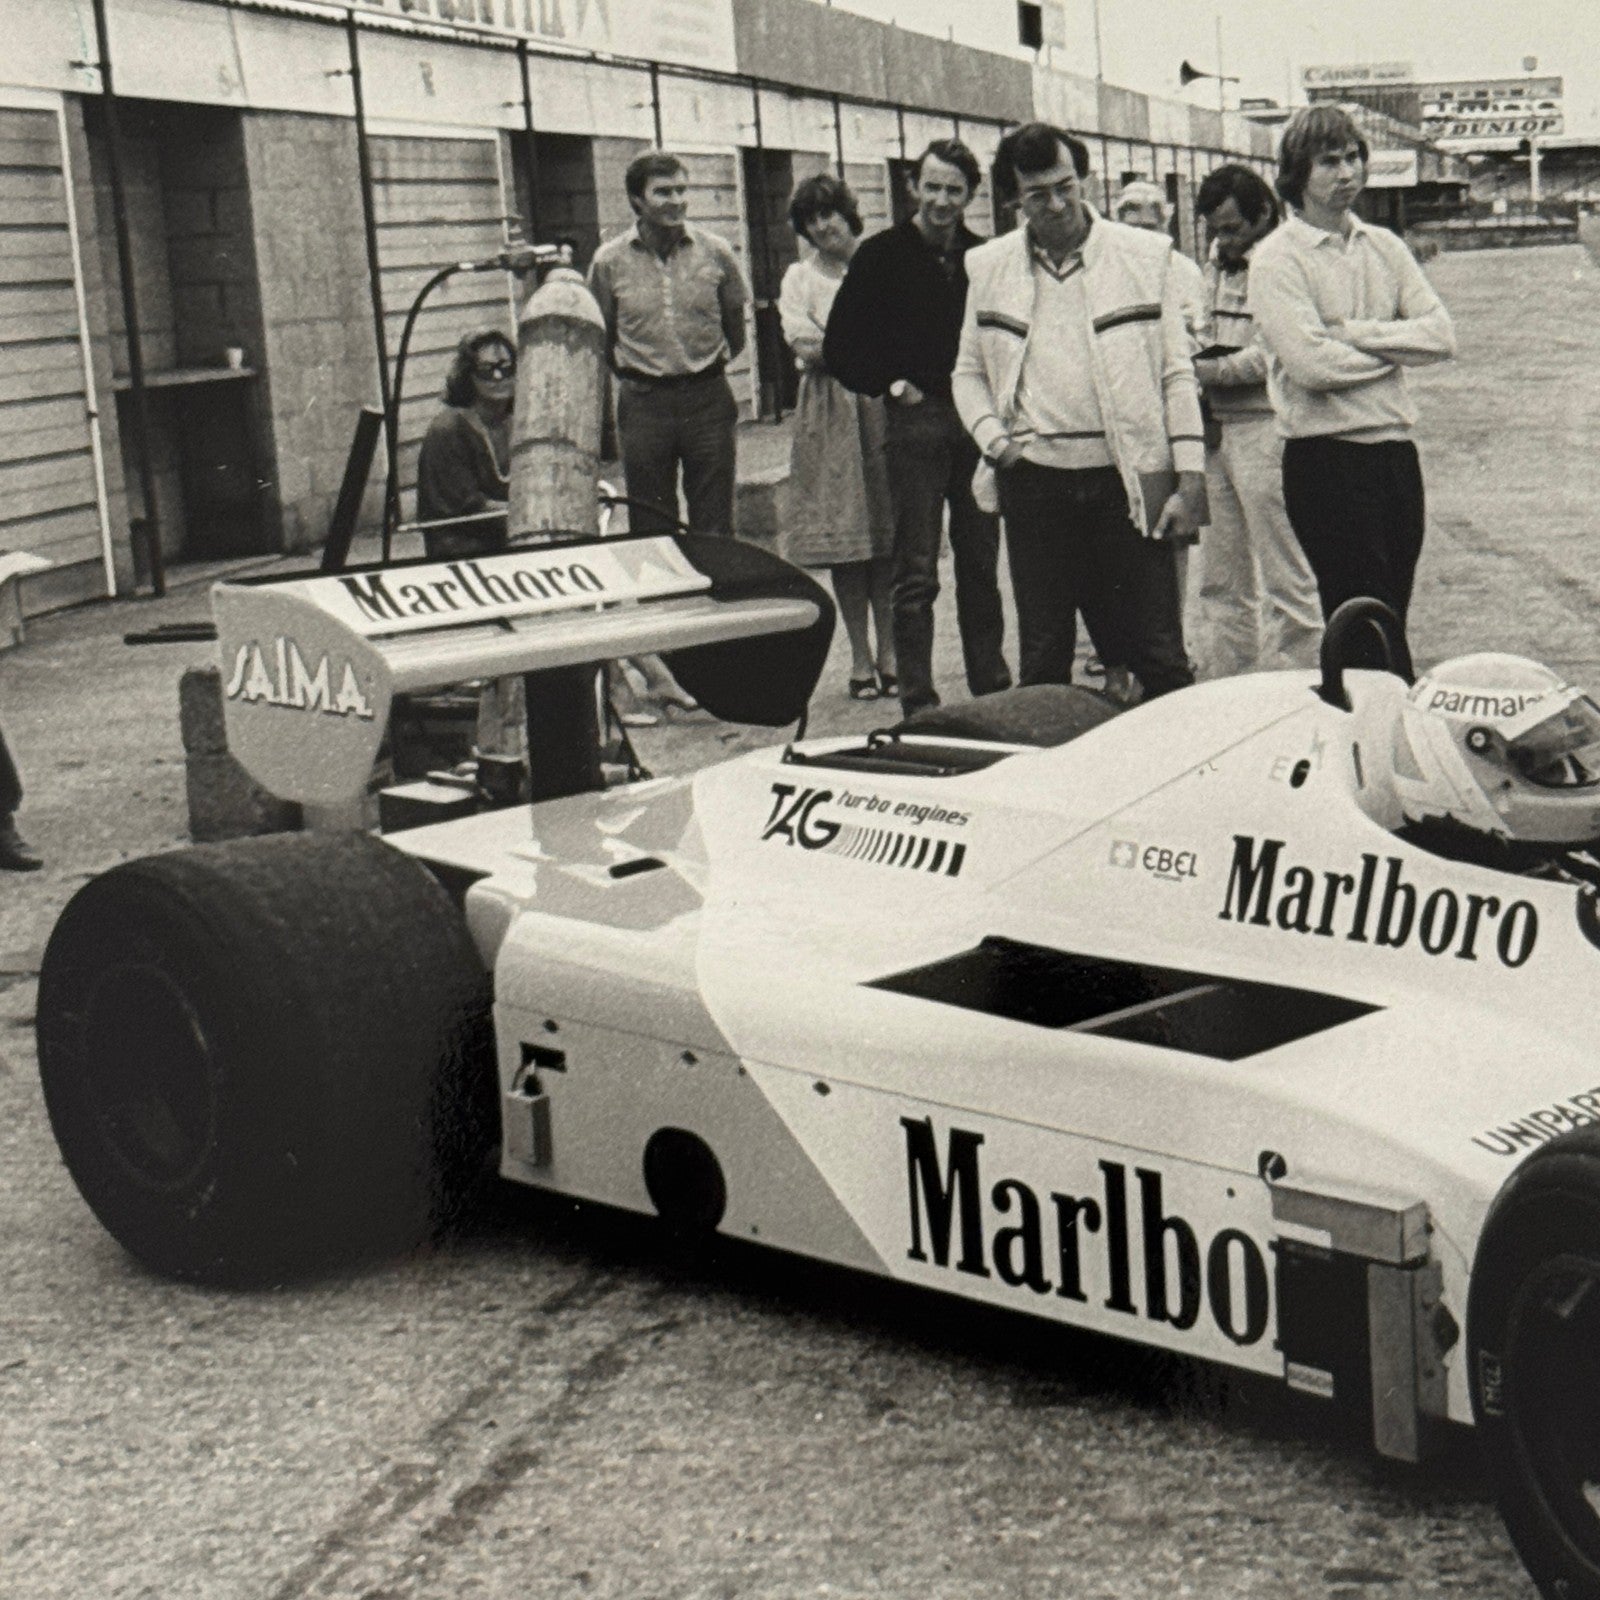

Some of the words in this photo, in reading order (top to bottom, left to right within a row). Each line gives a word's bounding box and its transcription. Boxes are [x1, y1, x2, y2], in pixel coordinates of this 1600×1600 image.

[1452, 118, 1557, 136] DUNLOP
[338, 560, 606, 622] Marlboro
[226, 635, 374, 721] SAIMA
[761, 782, 842, 850] TAG
[837, 790, 892, 813] turbo
[894, 801, 972, 826] engines
[1143, 845, 1198, 878] EBEL
[1218, 834, 1539, 968] Marlboro
[900, 1114, 1279, 1350] Marlbo
